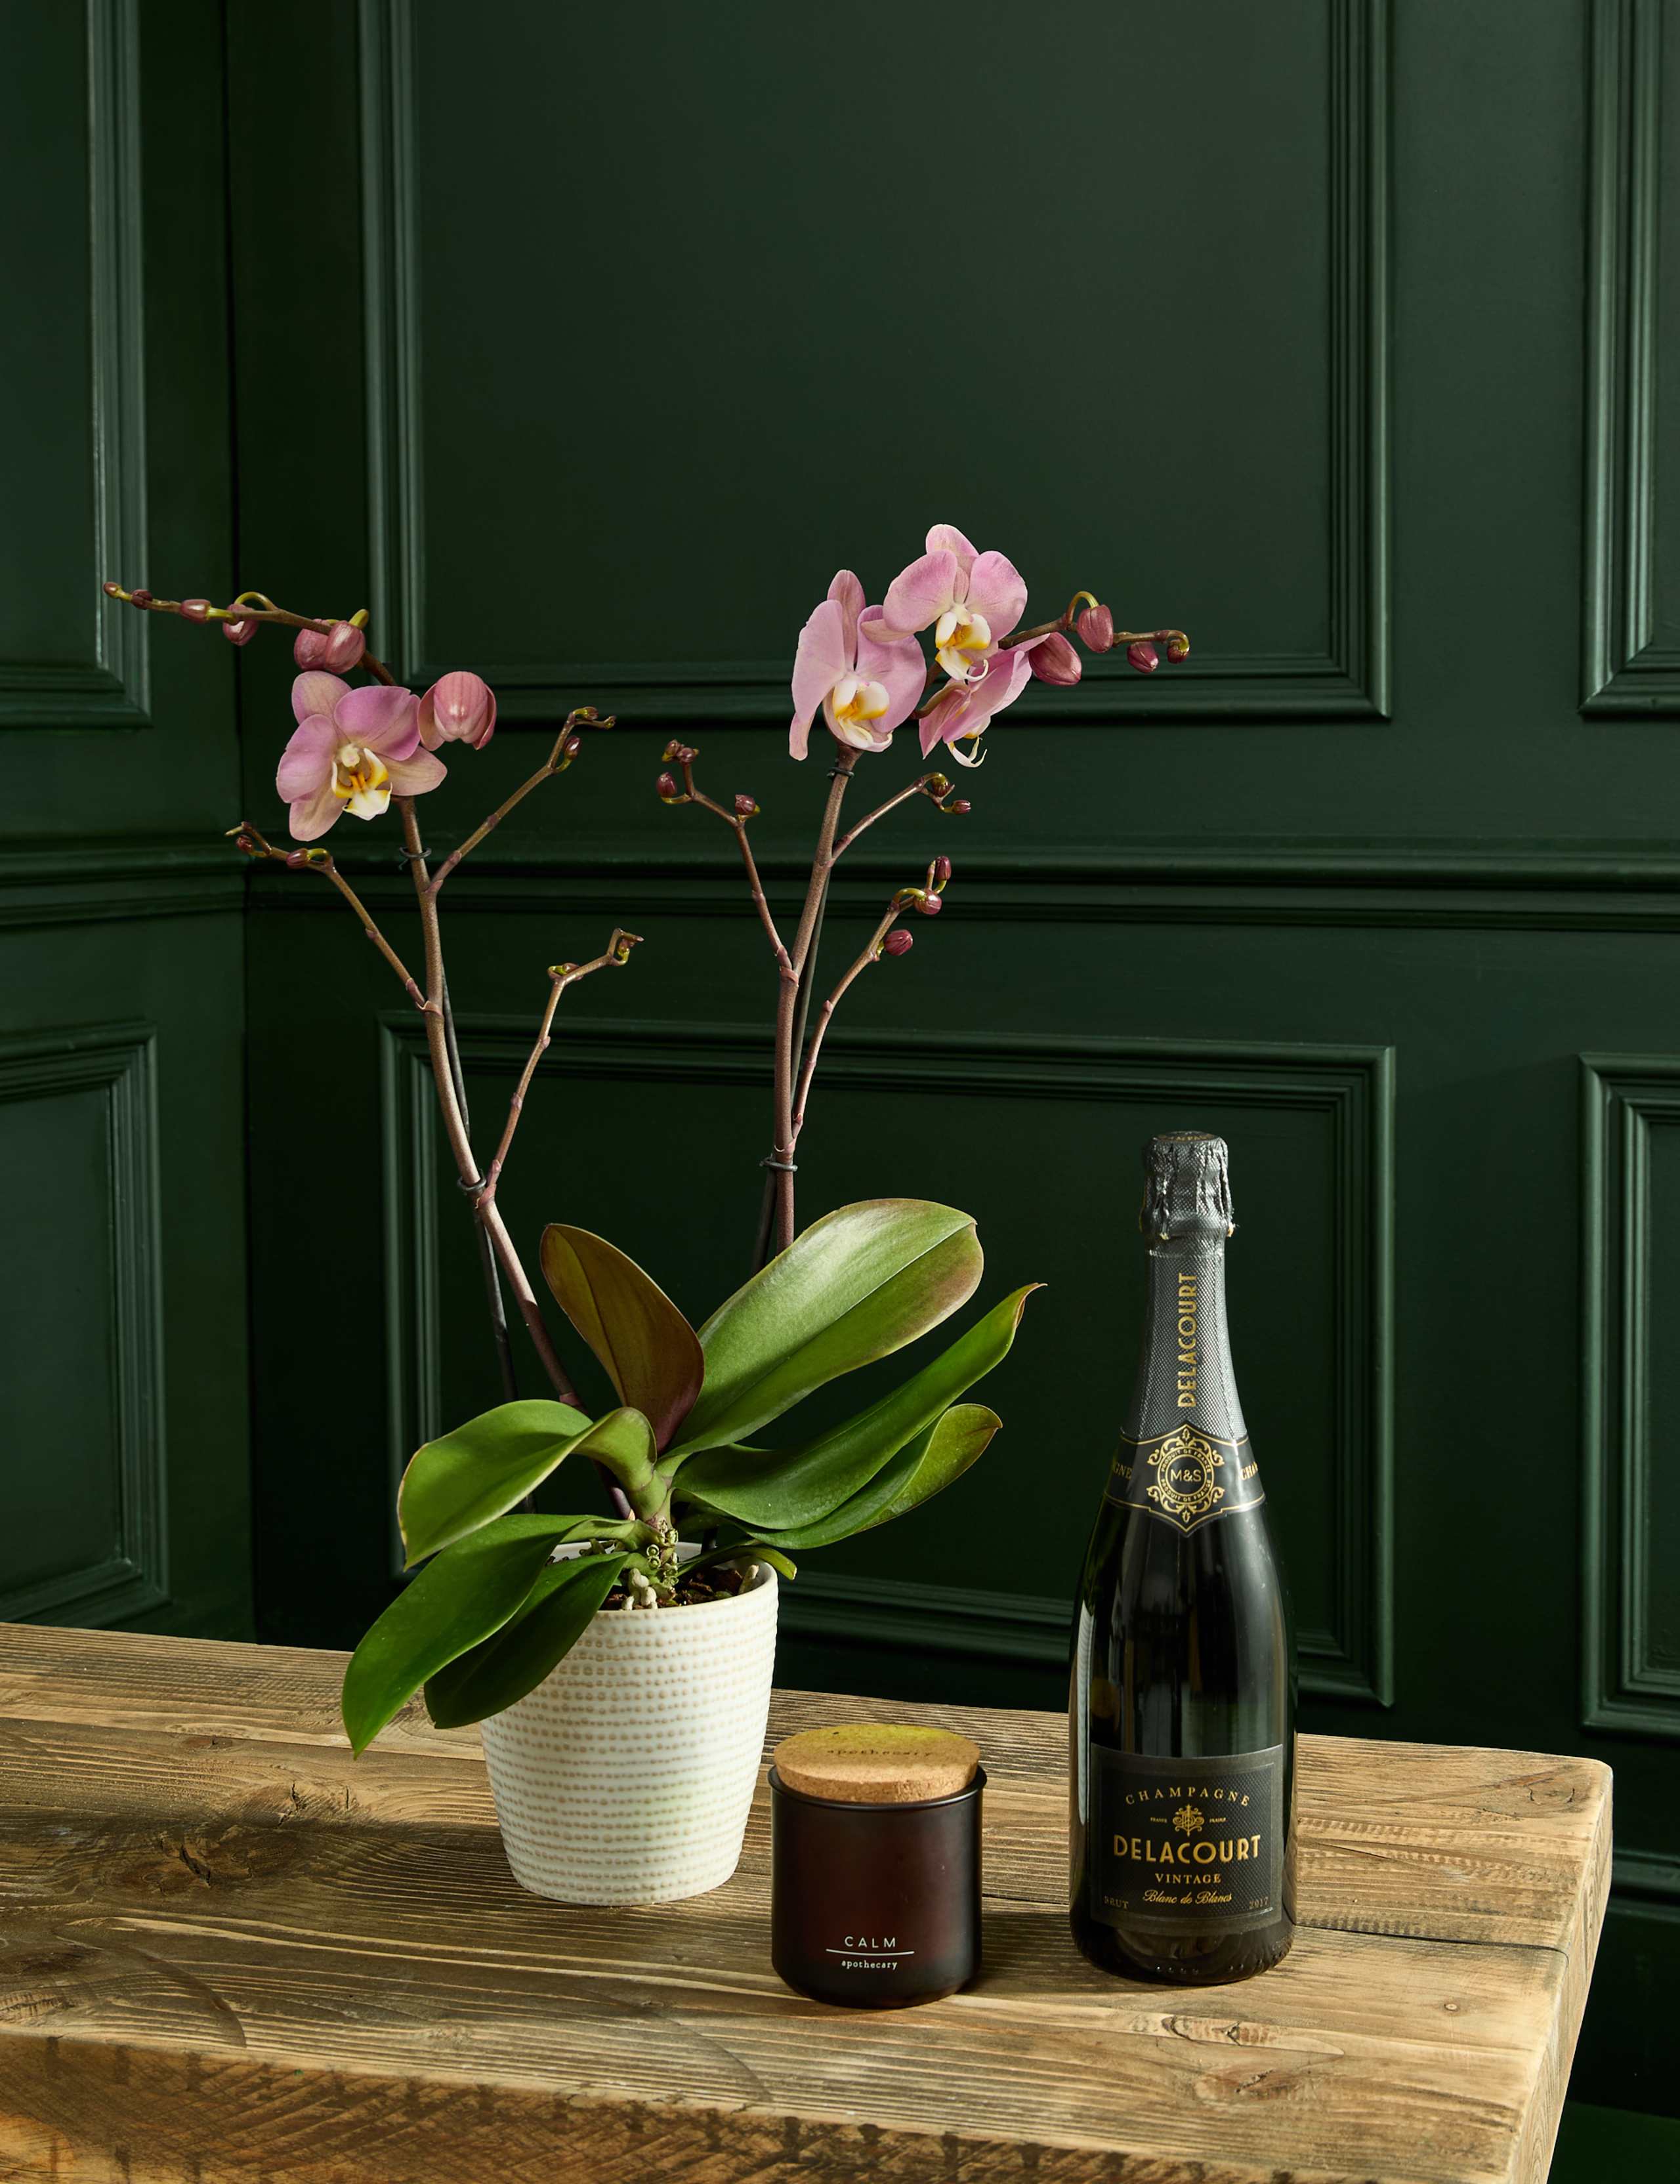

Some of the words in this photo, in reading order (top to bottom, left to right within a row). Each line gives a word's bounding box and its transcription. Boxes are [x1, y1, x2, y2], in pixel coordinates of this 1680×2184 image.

[1177, 1272, 1198, 1408] DELACOURT
[1161, 1448, 1181, 1472] PRODUIT
[1194, 1450, 1211, 1472] FRANCE
[1170, 1469, 1202, 1481] M&S
[1161, 1479, 1181, 1500] PRODUIT
[1194, 1479, 1211, 1500] FRANCE
[1125, 1786, 1250, 1806] CHAMPAGNE
[1114, 1834, 1261, 1864] DELACOURT
[1155, 1873, 1221, 1884] VINTAGE
[1104, 1895, 1129, 1909] BRUT
[1143, 1889, 1177, 1904] Blanc
[1180, 1891, 1192, 1904] de
[1195, 1890, 1232, 1904] Blancs
[1249, 1896, 1269, 1909] 2017
[845, 1936, 896, 1948] CALM
[841, 1960, 898, 1970] apothecary
